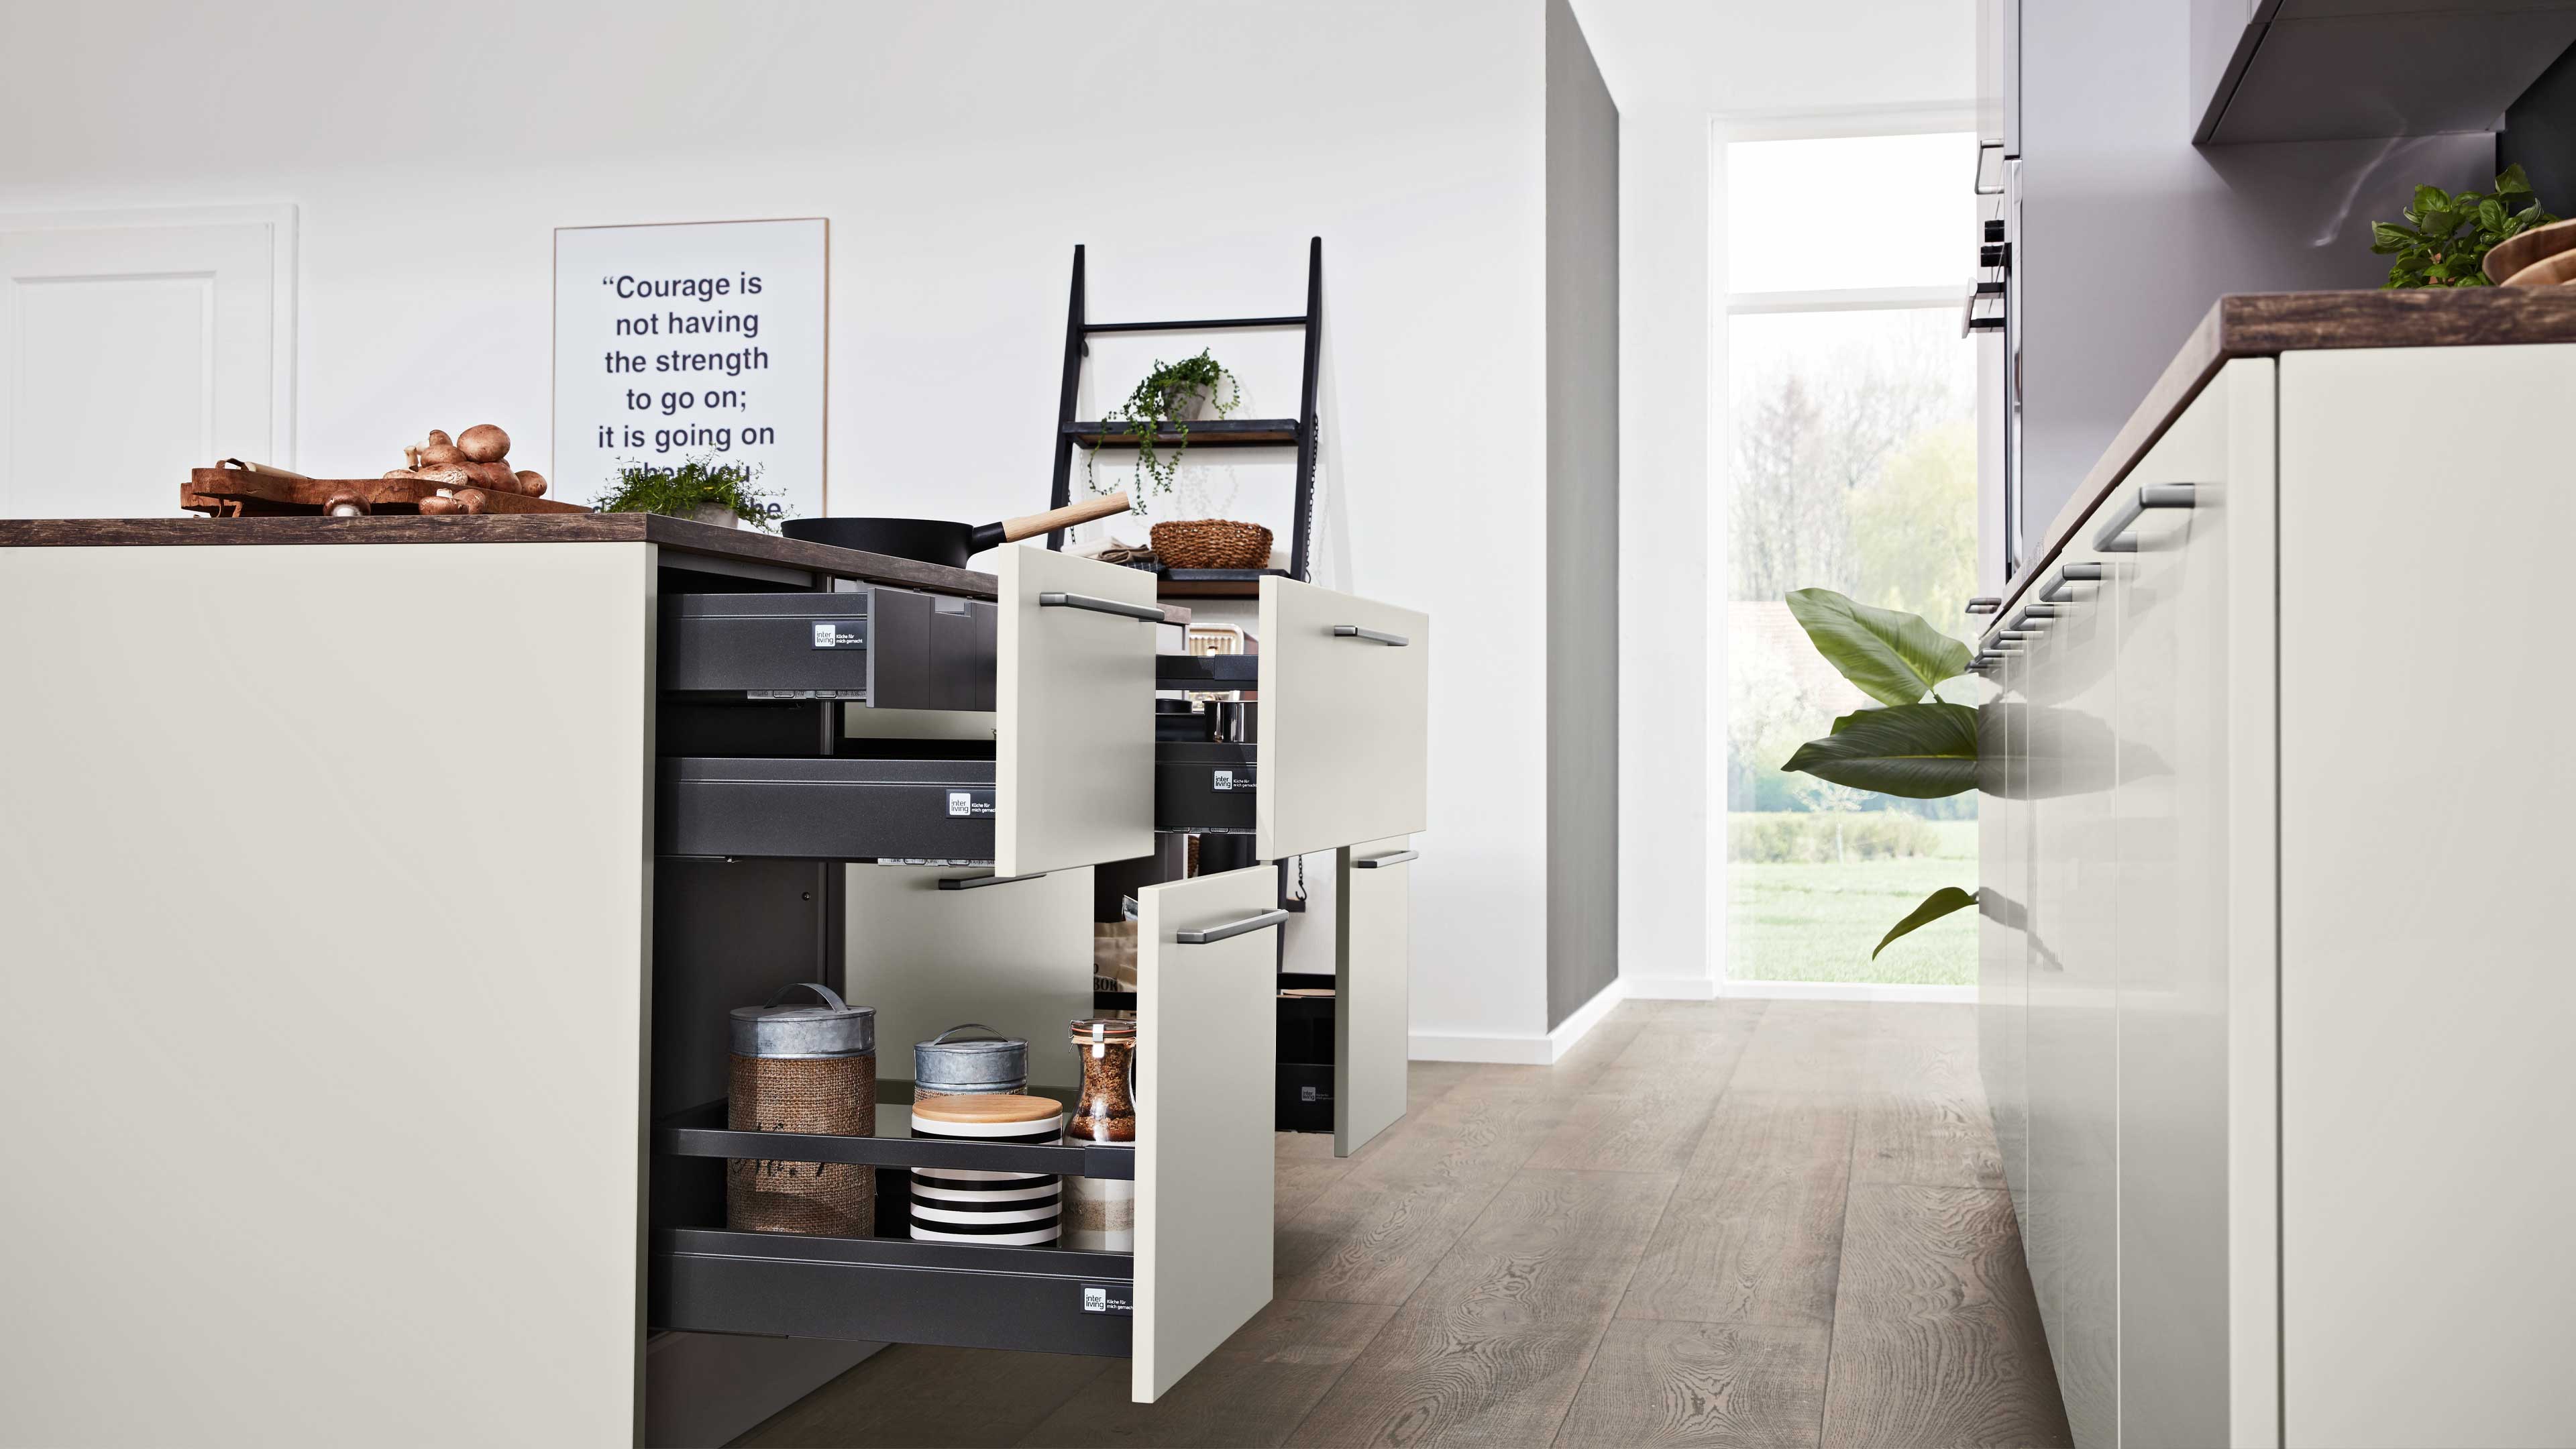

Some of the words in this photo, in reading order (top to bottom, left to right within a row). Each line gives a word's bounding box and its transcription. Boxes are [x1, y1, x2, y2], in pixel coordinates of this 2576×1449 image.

[602, 274, 731, 303] “Courage
[741, 271, 763, 294] is
[616, 313, 659, 336] not
[669, 310, 759, 339] having
[604, 351, 647, 374] the
[656, 346, 769, 376] strength
[626, 388, 651, 411] to
[661, 391, 695, 416] go
[704, 390, 747, 412] on;
[598, 425, 614, 448] it
[624, 425, 645, 447] is
[655, 423, 731, 453] going
[741, 427, 775, 445] on
[816, 637, 834, 645] living
[951, 805, 969, 813] living
[1086, 1300, 1104, 1309] living
